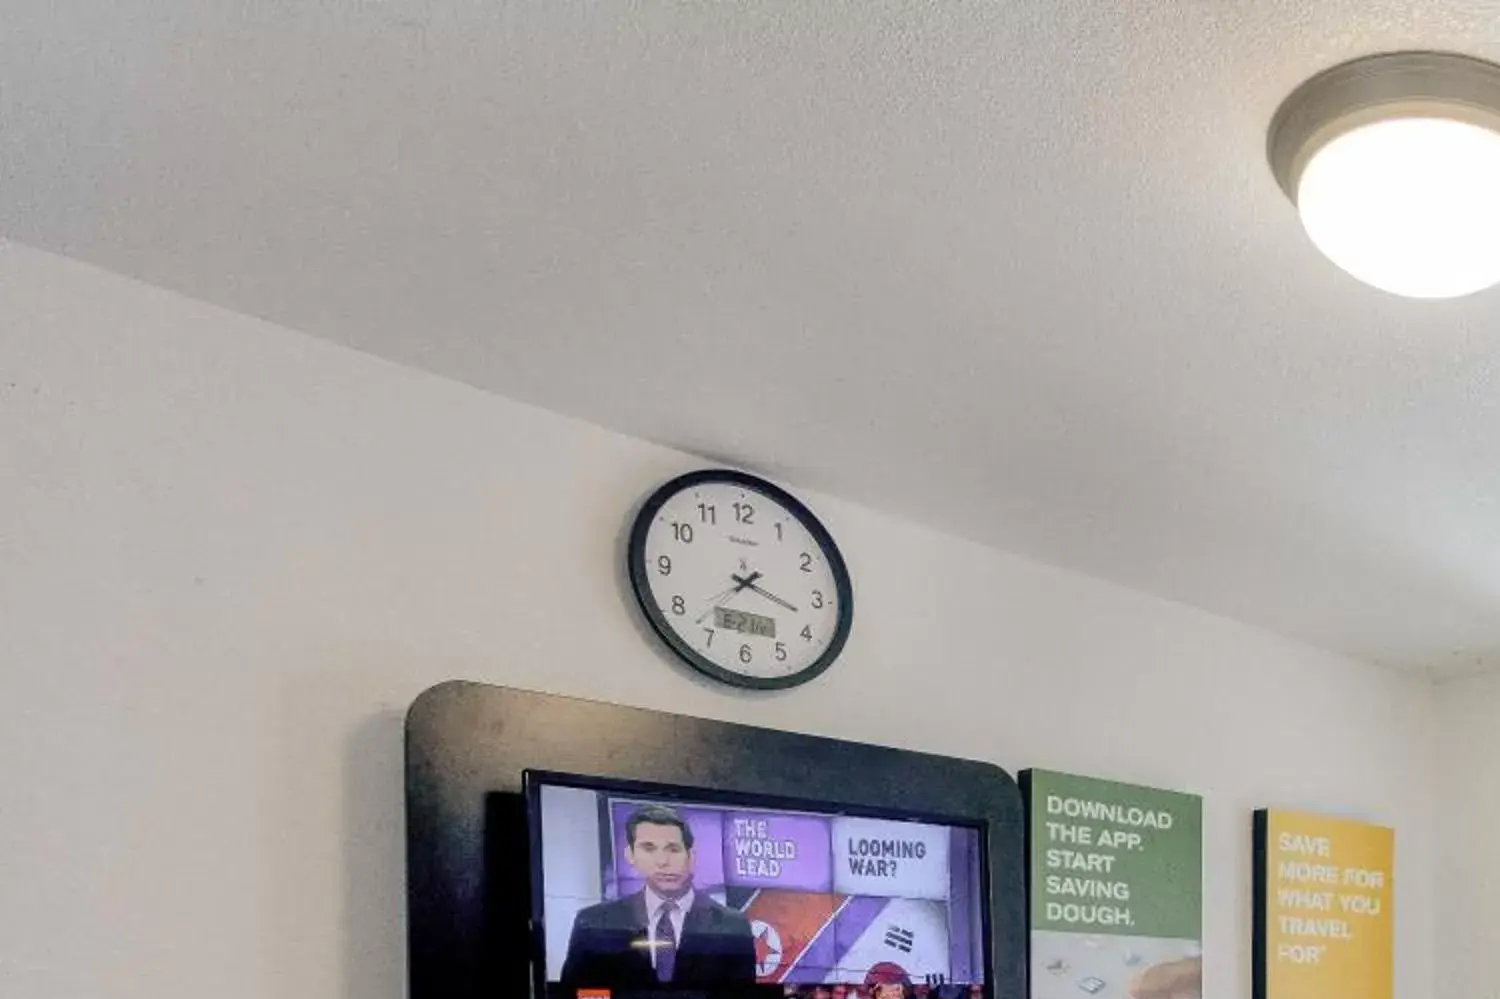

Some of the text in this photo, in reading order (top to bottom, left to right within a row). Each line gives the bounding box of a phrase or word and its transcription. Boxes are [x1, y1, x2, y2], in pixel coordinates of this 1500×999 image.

[698, 503, 716, 525] 11
[732, 502, 755, 524] 12
[672, 522, 693, 543] 10
[774, 522, 784, 541] 1
[657, 555, 672, 576] 9
[800, 552, 812, 573] 2
[671, 595, 685, 616] 8
[811, 591, 823, 609] 3
[703, 628, 715, 649] 7
[800, 624, 812, 642] 4
[739, 644, 752, 664] 6
[775, 642, 787, 661] 5
[1047, 795, 1172, 829] DOWNLOAD
[734, 819, 768, 839] THE
[1045, 821, 1144, 851] THE APP.
[735, 838, 796, 859] WORLD
[848, 838, 926, 859] LOOMING
[1279, 832, 1330, 857] SAVE
[736, 857, 780, 877] LEAD
[849, 859, 897, 877] WAR?
[1046, 849, 1116, 873] START
[1279, 862, 1384, 888] MORE FOR
[1046, 875, 1130, 900] SAVING
[1278, 890, 1380, 915] WHAT YOU
[1278, 915, 1351, 940] TRAVEL
